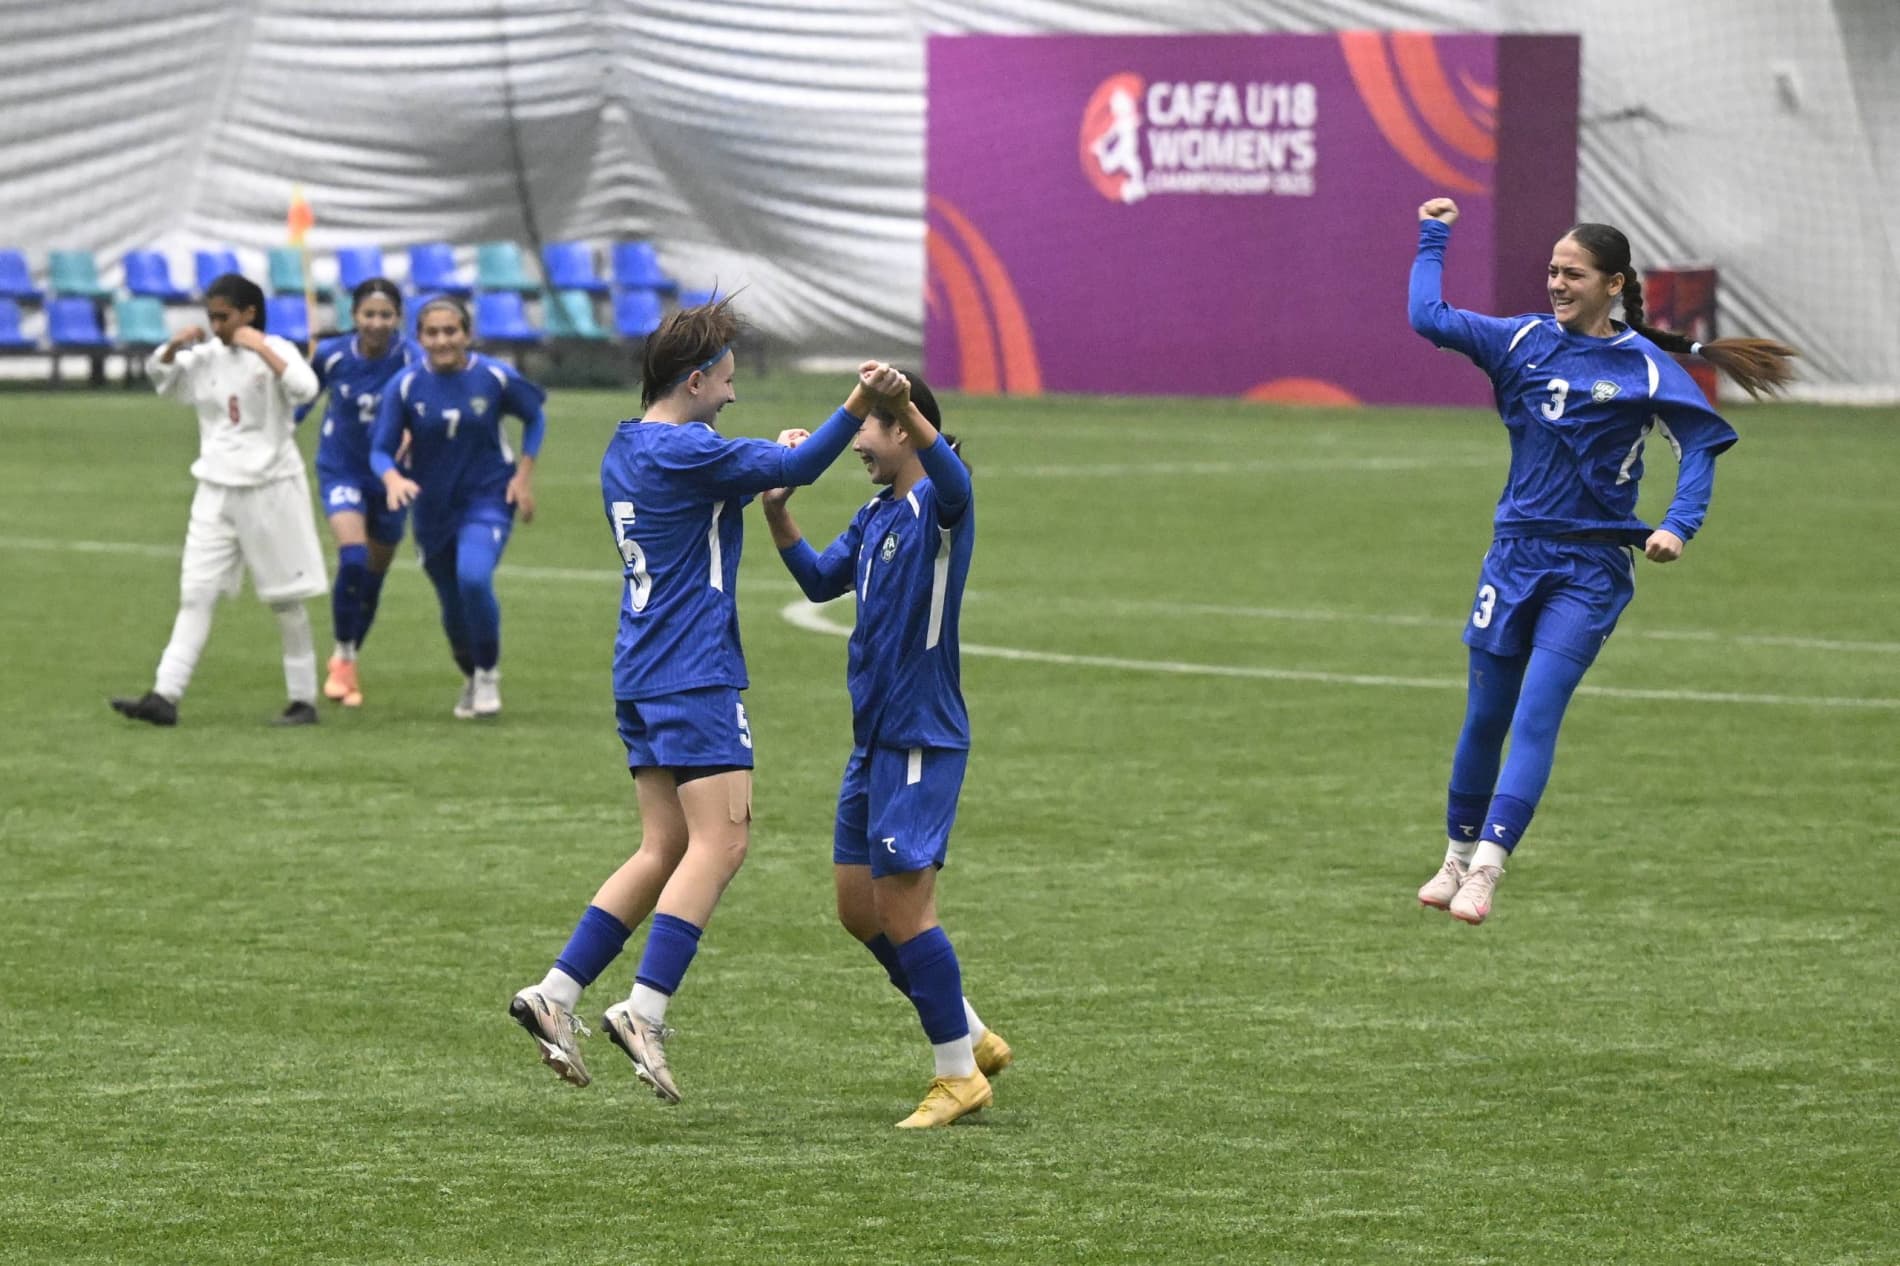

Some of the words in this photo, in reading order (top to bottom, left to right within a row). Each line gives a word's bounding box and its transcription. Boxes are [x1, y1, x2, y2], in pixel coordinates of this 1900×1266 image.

[1147, 81, 1242, 126] CAFA
[1246, 82, 1317, 127] U18
[1147, 129, 1317, 171] WOMEN'S
[1541, 378, 1569, 421] 3
[441, 407, 461, 440] 7
[611, 501, 652, 612] 5
[1472, 584, 1496, 629] 3
[735, 702, 753, 749] 5
